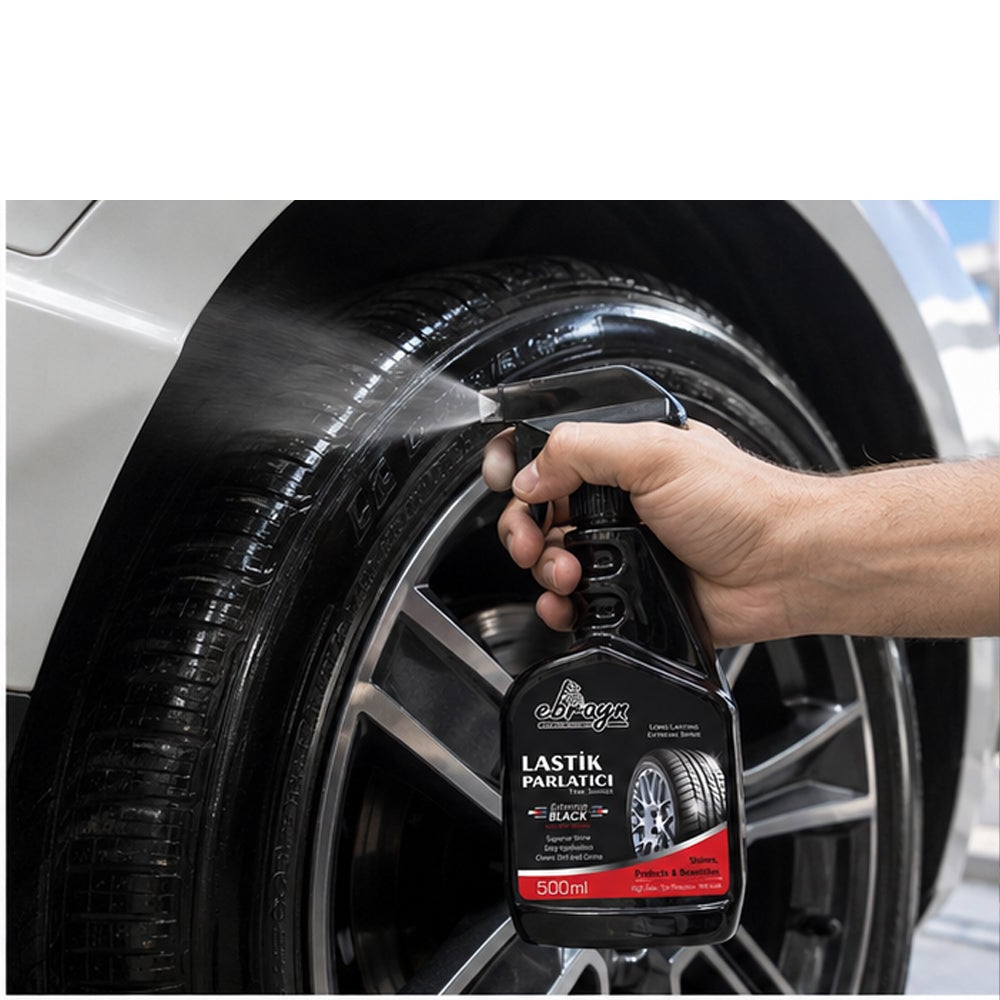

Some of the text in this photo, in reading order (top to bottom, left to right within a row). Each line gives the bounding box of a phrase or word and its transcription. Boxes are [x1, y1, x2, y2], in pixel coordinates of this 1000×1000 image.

[522, 751, 603, 772] LASTİK
[522, 774, 614, 789] PARLATICI
[549, 811, 587, 822] BLACK
[537, 880, 588, 895] 500ml
